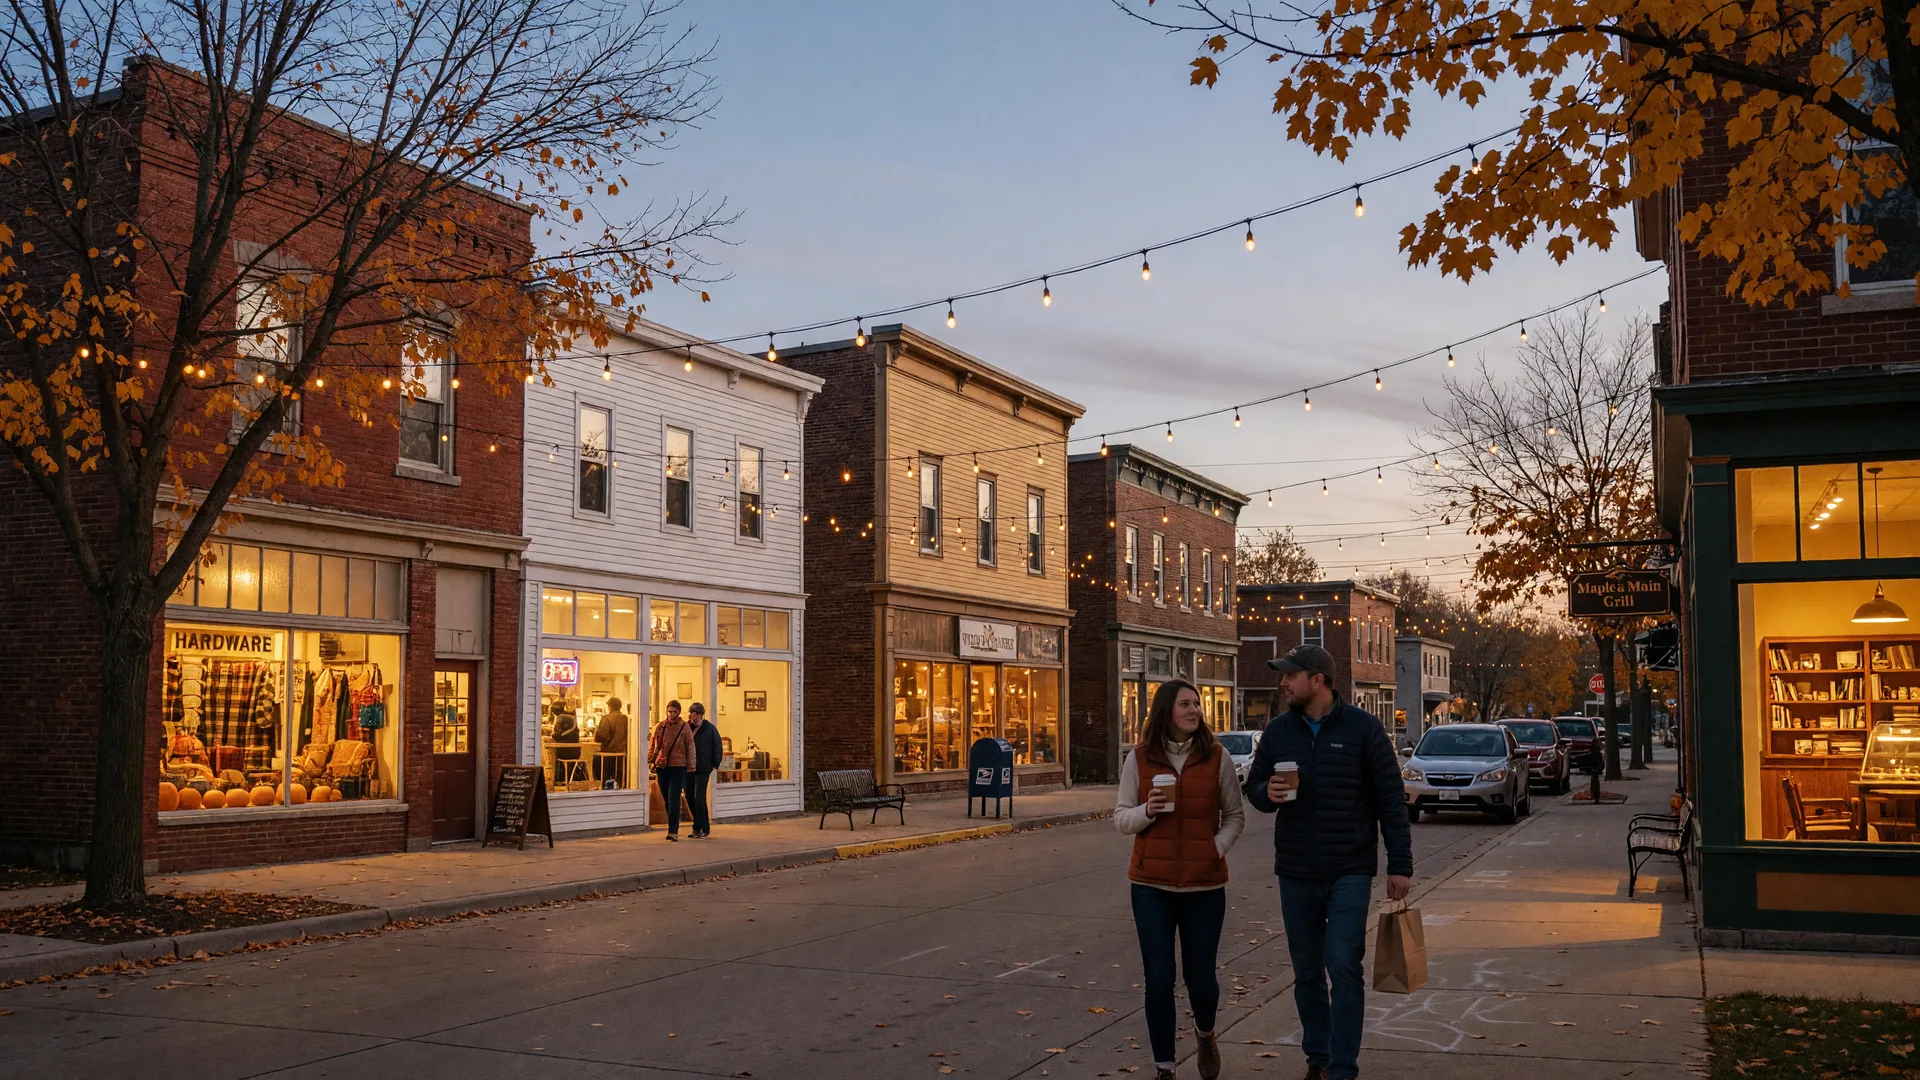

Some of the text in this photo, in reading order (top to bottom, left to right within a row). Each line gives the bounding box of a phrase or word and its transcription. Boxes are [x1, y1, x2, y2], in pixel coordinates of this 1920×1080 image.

[1577, 582, 1616, 596] Maple
[1627, 580, 1662, 592] Main
[1603, 595, 1635, 608] Grill
[175, 632, 272, 653] HARDWARE
